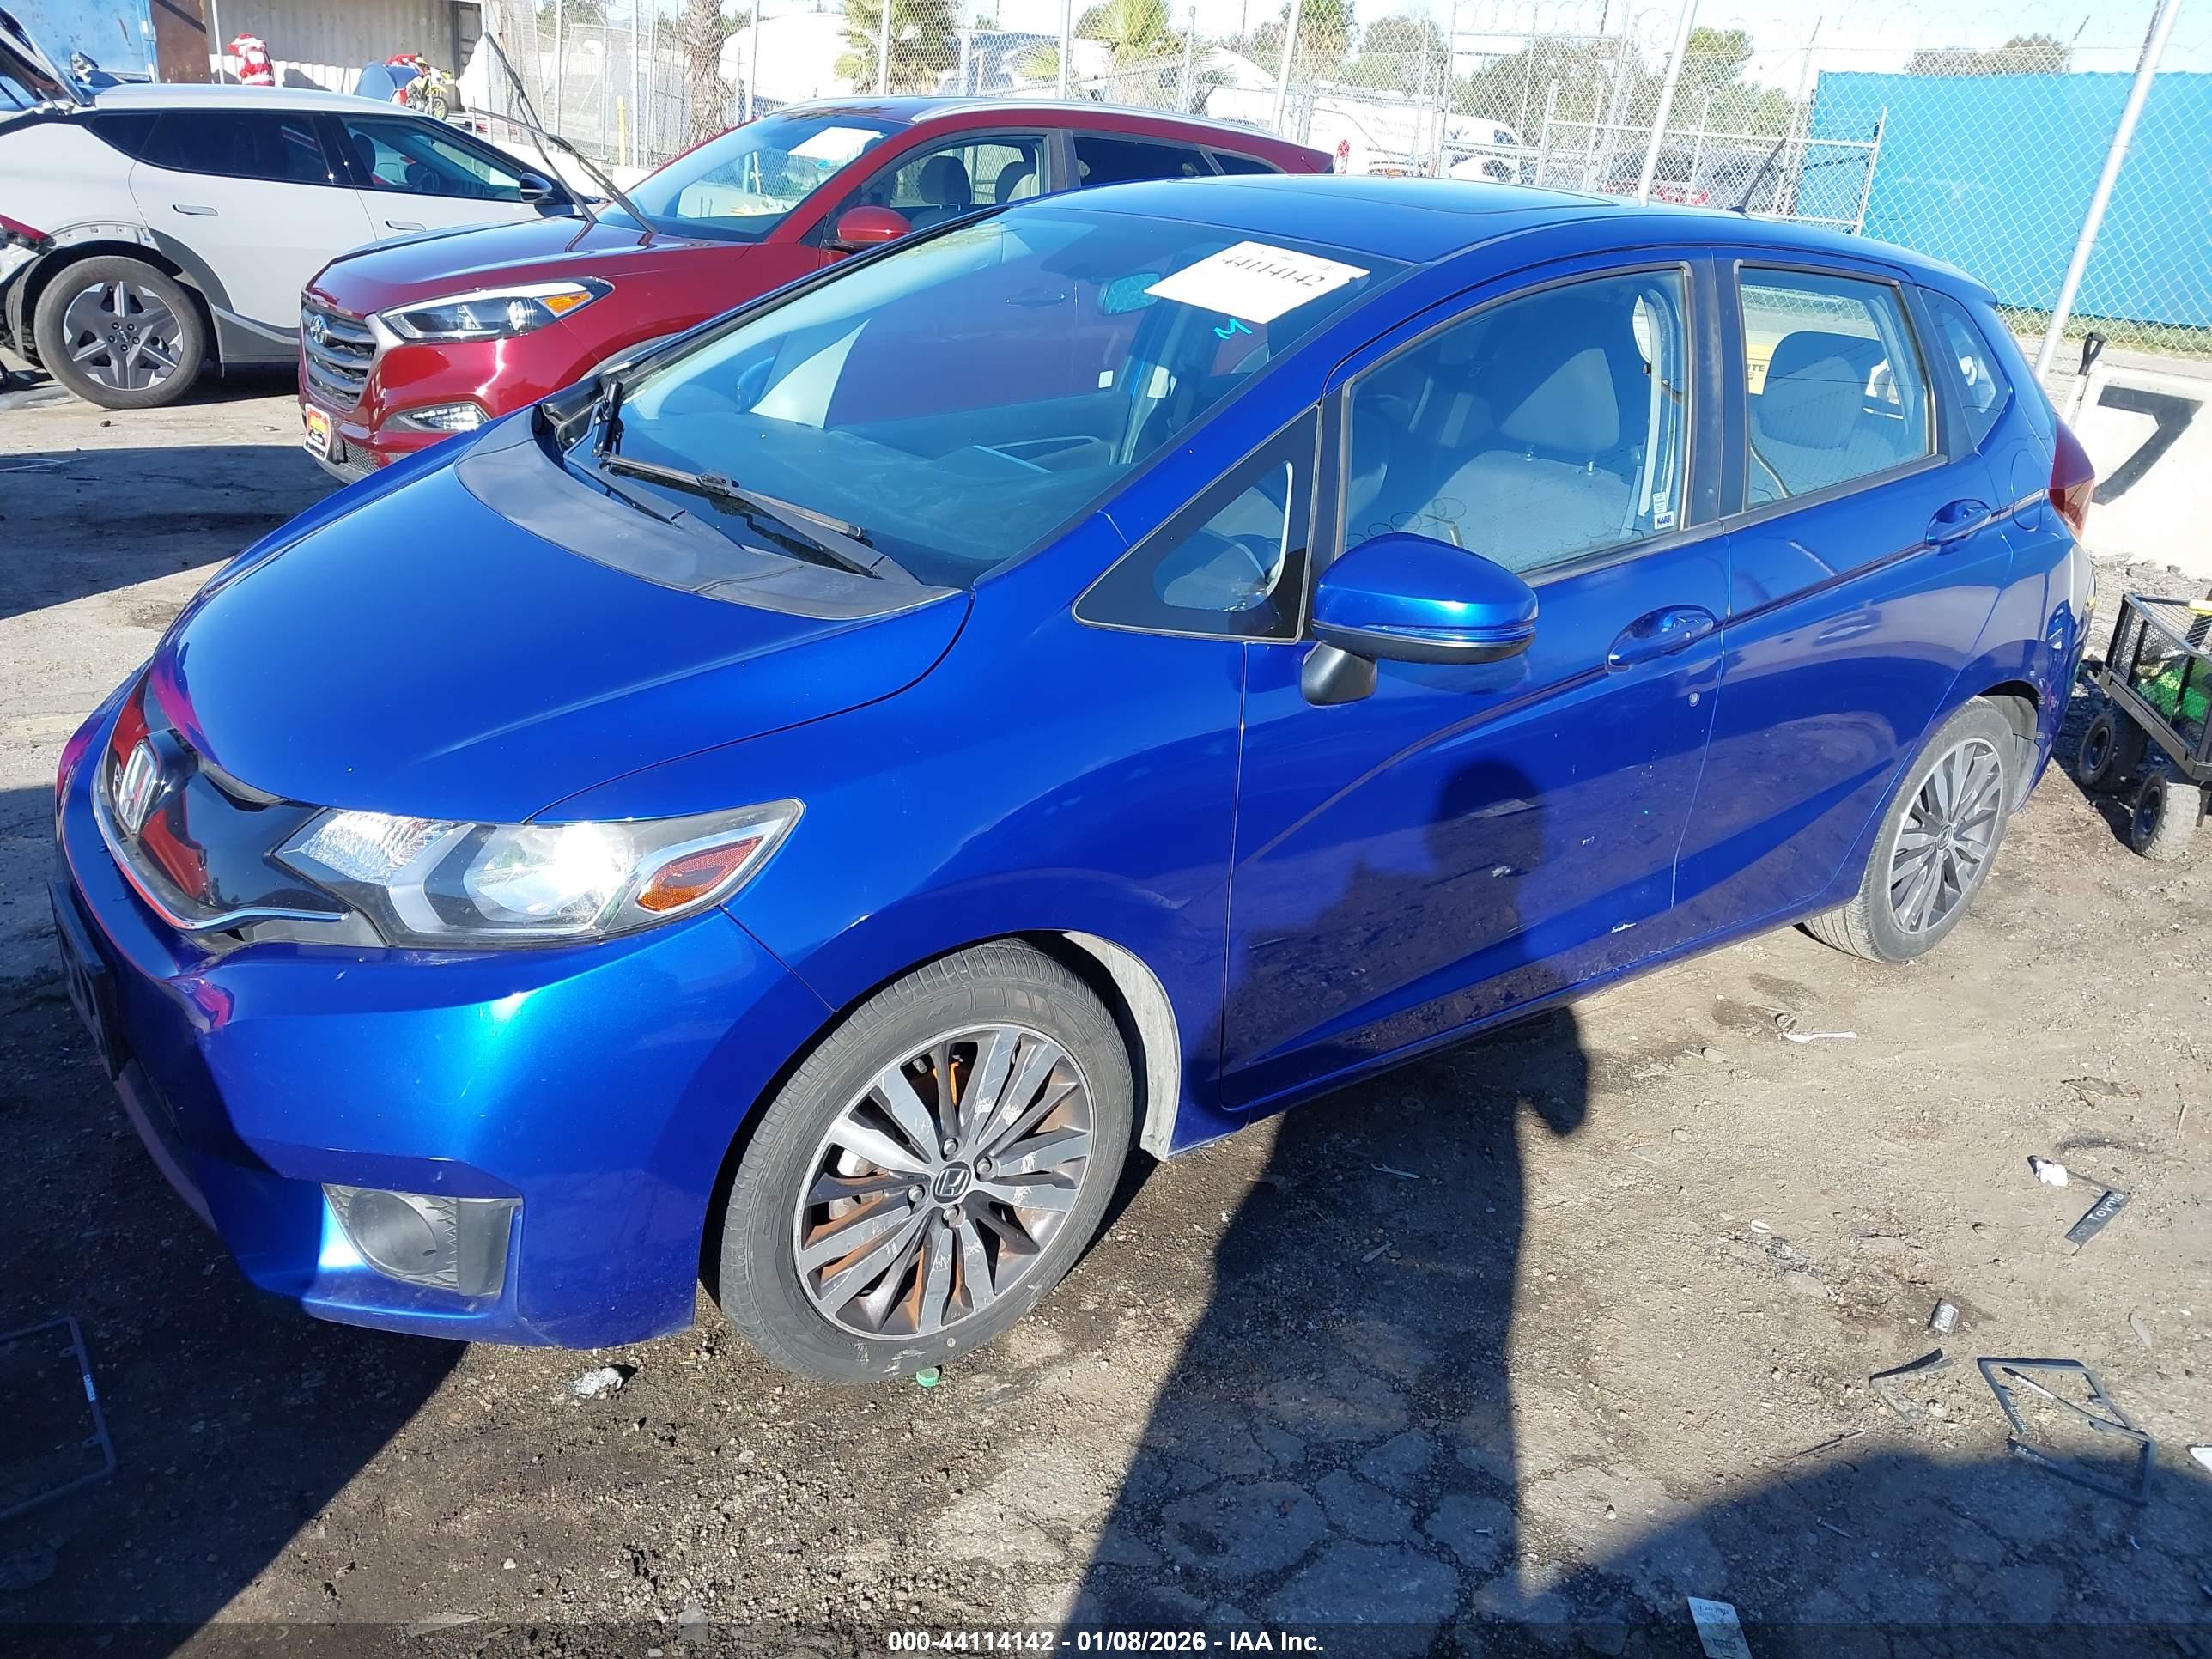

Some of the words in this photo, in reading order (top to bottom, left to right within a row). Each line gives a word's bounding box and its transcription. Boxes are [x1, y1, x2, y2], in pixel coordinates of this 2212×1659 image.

[2092, 385, 2204, 506] 7
[2086, 1193, 2124, 1222] Toyota
[1934, 1303, 1959, 1333] Family
